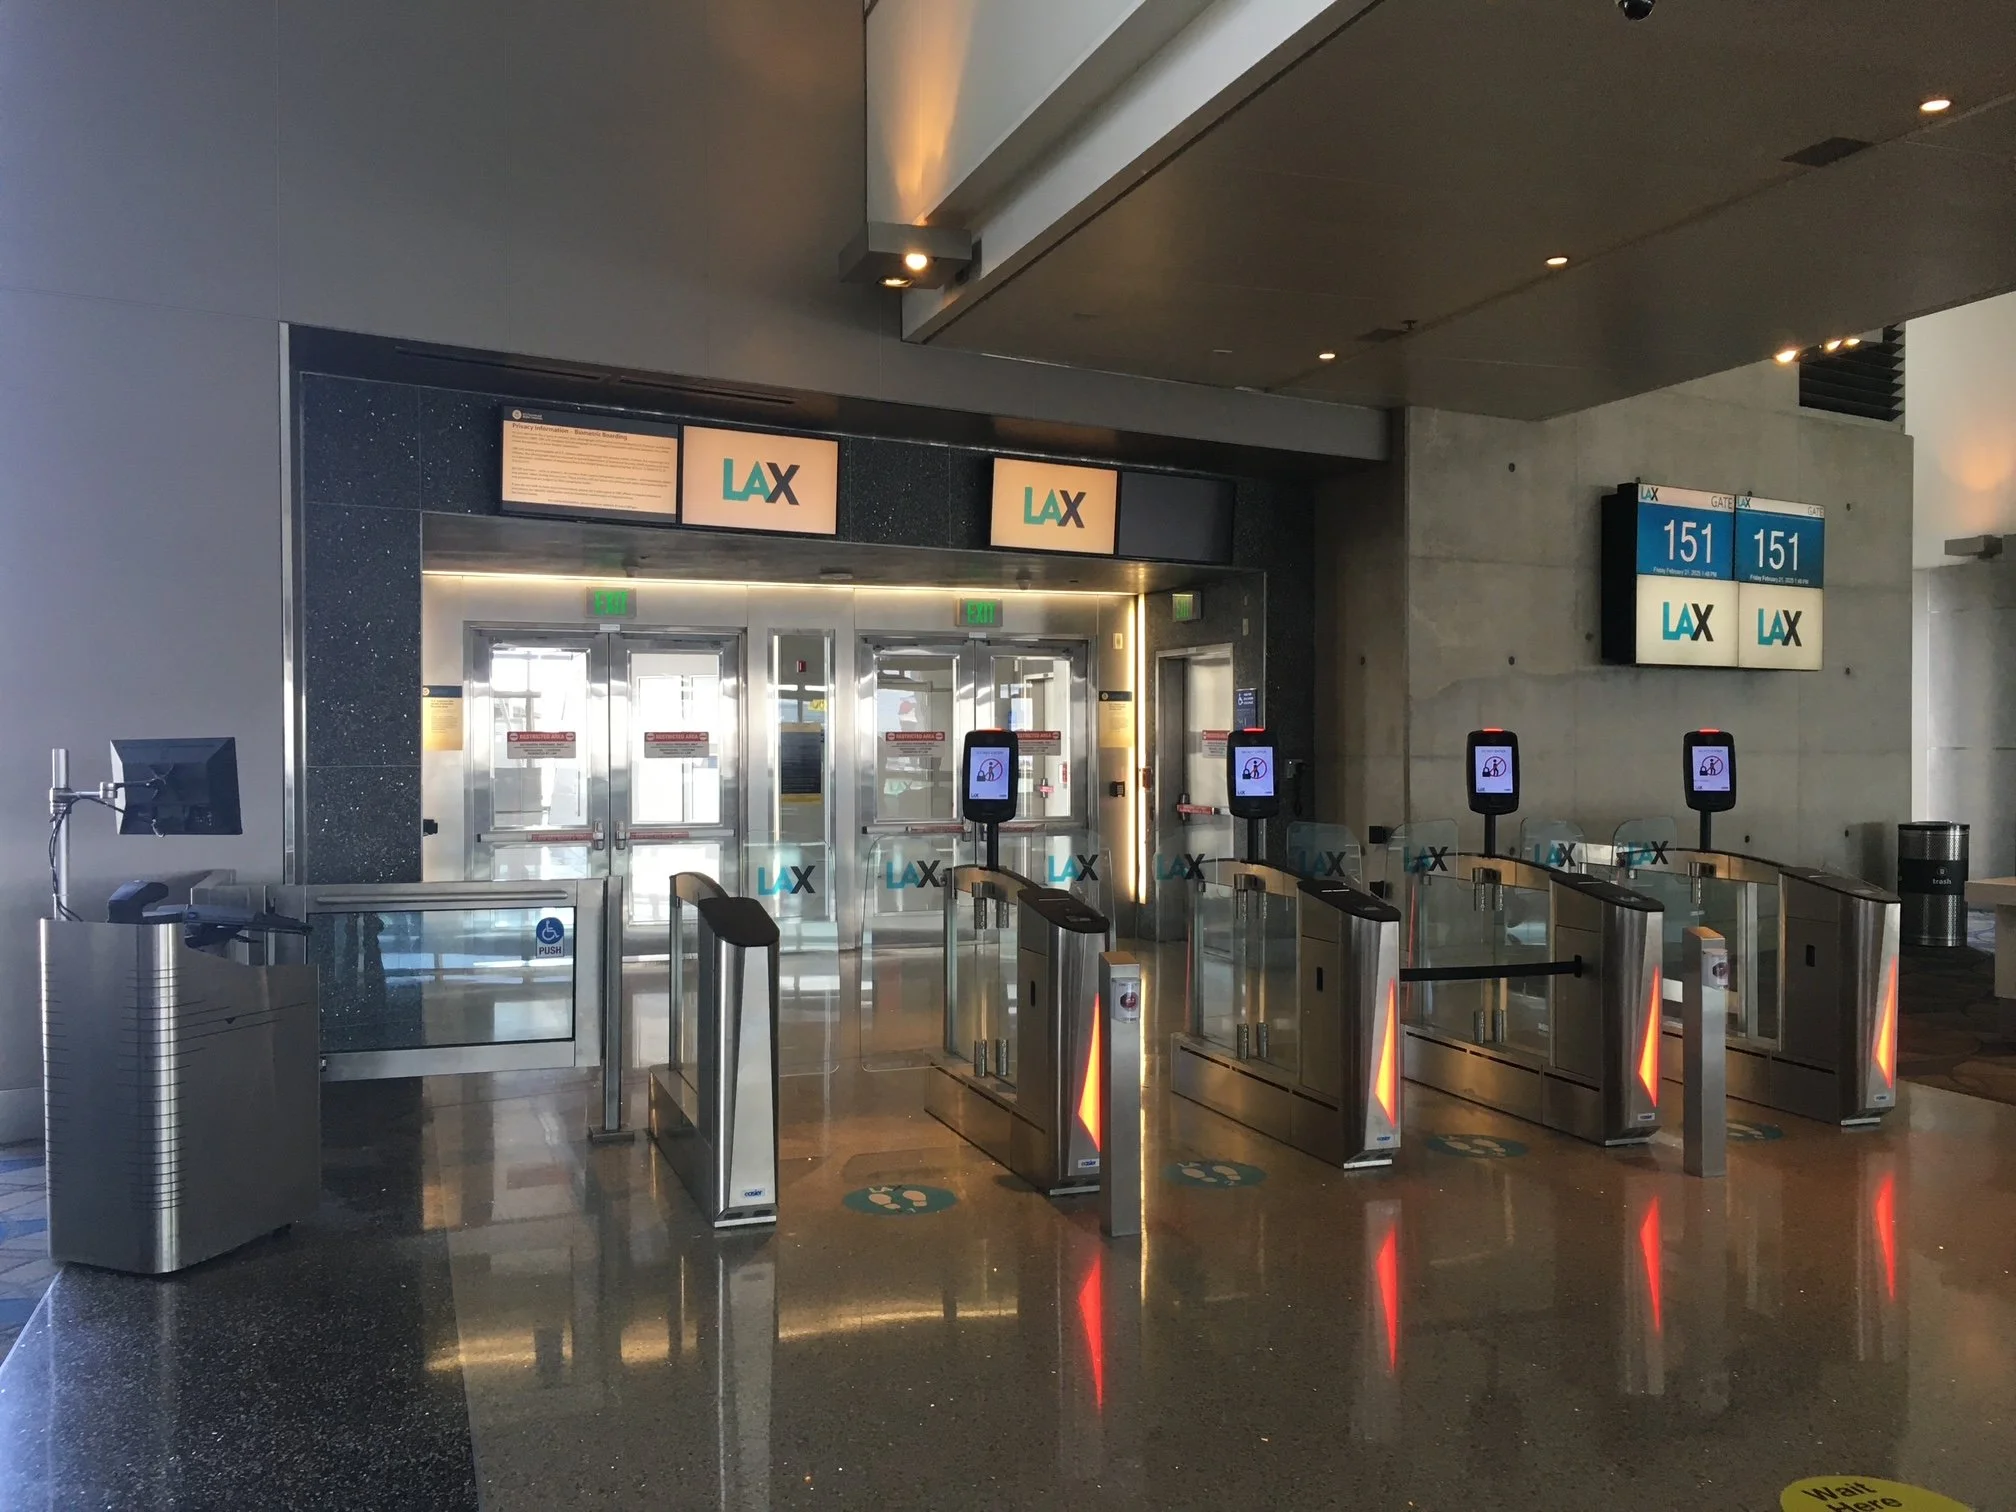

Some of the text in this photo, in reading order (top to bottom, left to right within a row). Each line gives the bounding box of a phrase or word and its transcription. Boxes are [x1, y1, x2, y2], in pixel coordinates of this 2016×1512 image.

[512, 423, 533, 431] Privacy
[602, 432, 628, 441] Boarding
[723, 458, 800, 505] LAX
[1641, 486, 1659, 502] LAX
[1024, 487, 1087, 529] LAX
[1711, 495, 1733, 511] GATE
[1738, 496, 1751, 509] LAX
[1807, 506, 1824, 518] GATE
[1664, 519, 1712, 564] 151
[1754, 528, 1799, 571] 151
[595, 591, 628, 616] EXIT
[967, 601, 996, 624] EXIT
[1663, 602, 1714, 642] LAX
[1758, 608, 1802, 647] LAX
[1156, 853, 1206, 880] LAX
[1404, 846, 1449, 873] LAX
[1628, 840, 1669, 867] LAX
[758, 865, 816, 896] LAX
[886, 860, 942, 889] LAX
[1048, 854, 1099, 882] LAX
[539, 946, 562, 955] PUSH
[1801, 1482, 1878, 1502] Wait
[1826, 1496, 1903, 1512] Here
